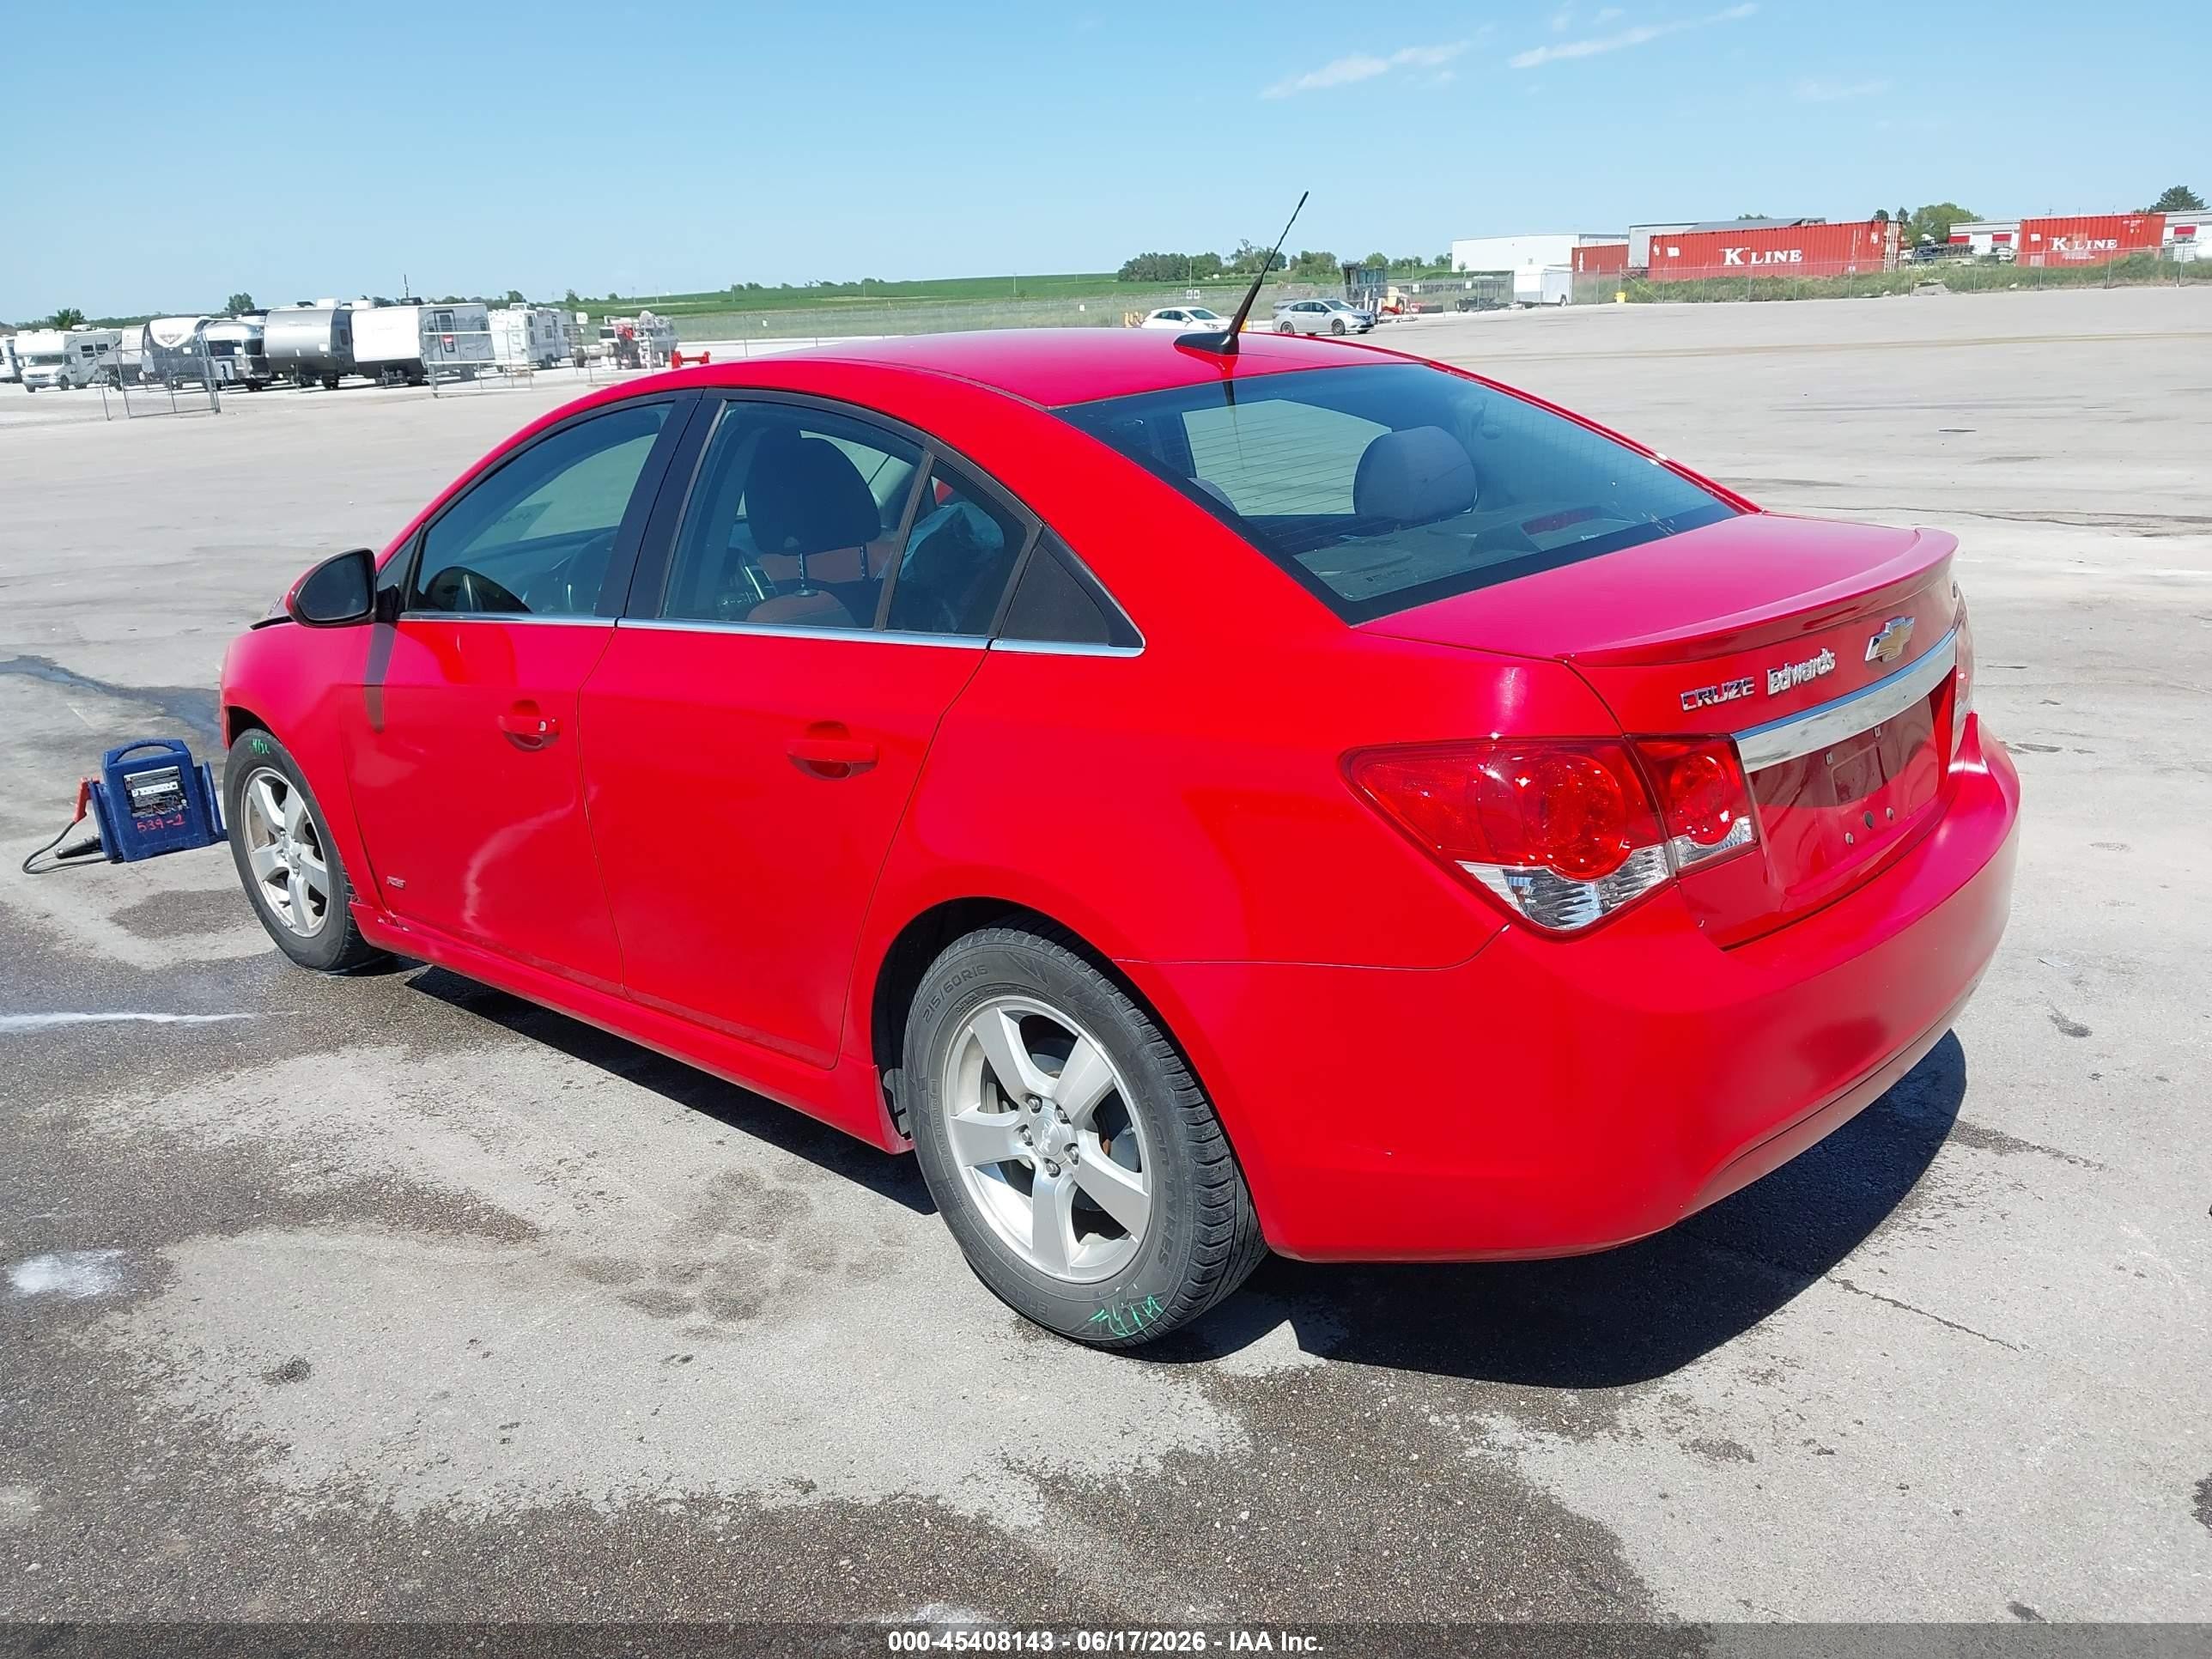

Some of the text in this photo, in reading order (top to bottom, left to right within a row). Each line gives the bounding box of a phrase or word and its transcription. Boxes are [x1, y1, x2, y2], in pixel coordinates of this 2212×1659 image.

[2074, 239, 2118, 249] LINE
[1751, 249, 1802, 264] LINE
[1680, 647, 1836, 711] CRUZE Edwards
